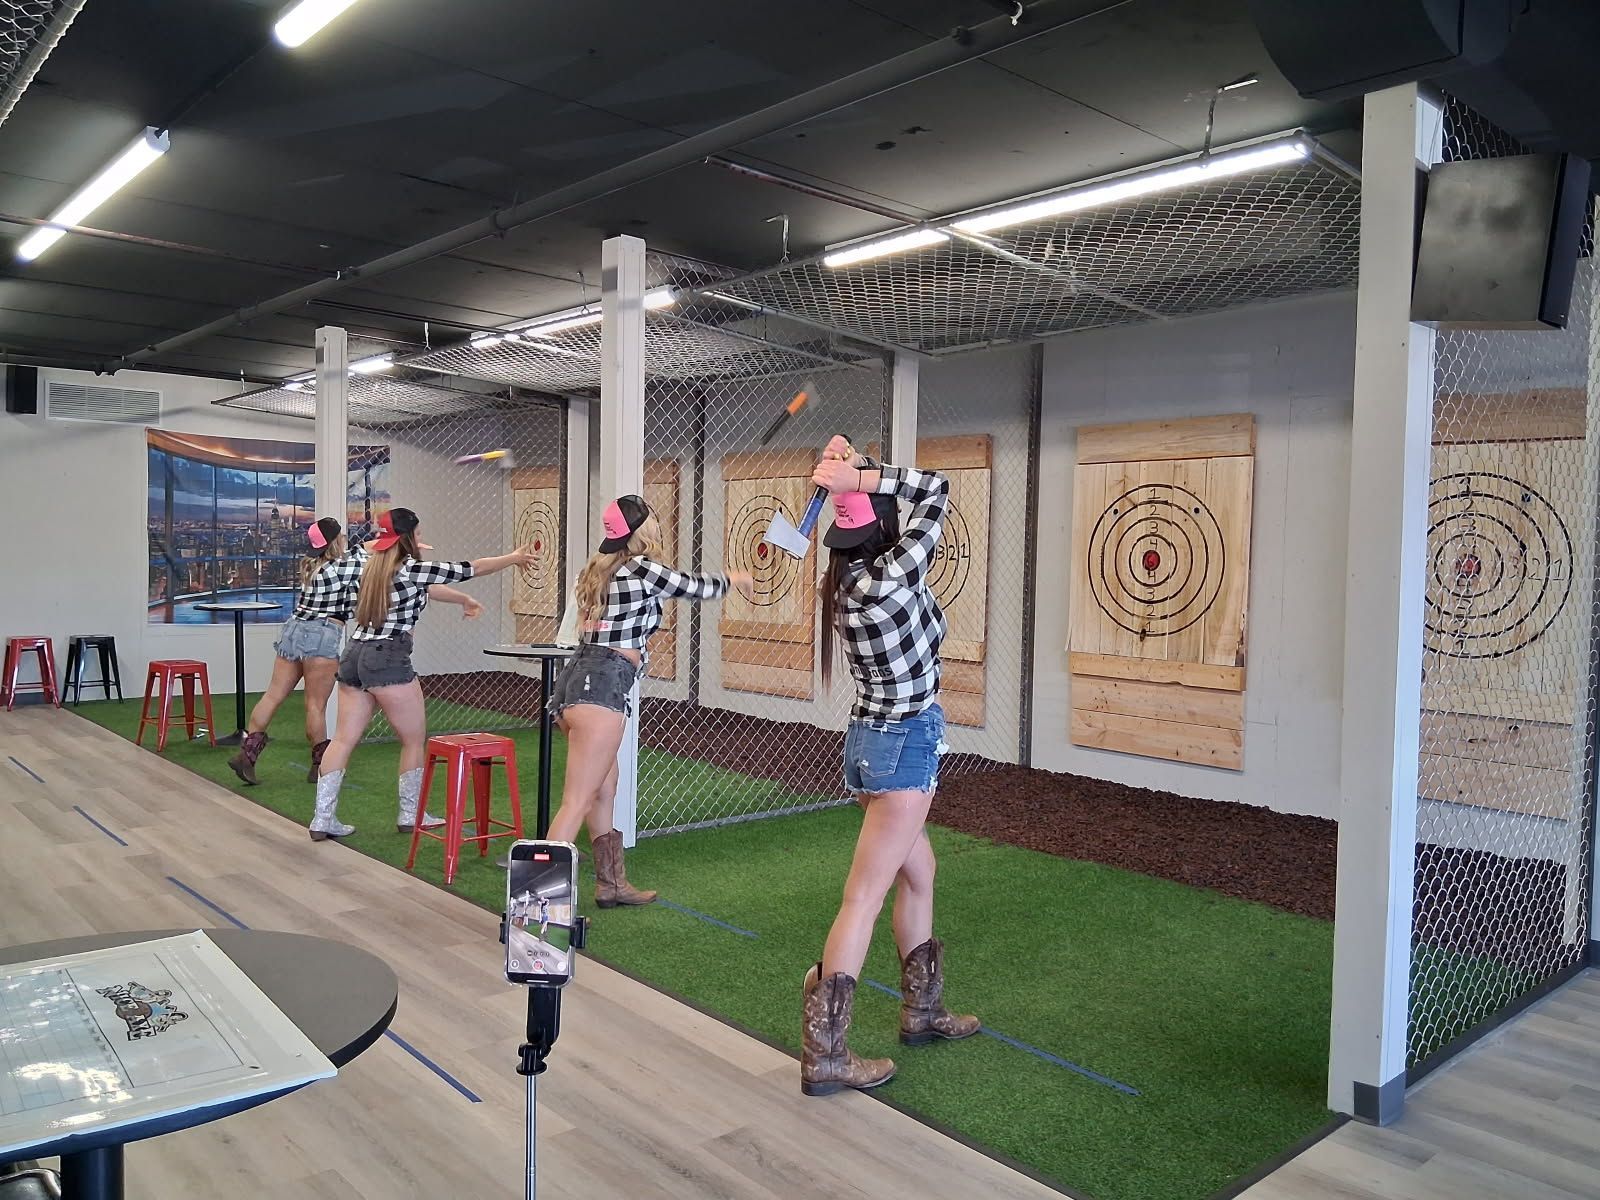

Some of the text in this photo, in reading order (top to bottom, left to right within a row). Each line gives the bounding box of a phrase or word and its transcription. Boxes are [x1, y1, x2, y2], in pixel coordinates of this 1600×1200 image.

[1148, 487, 1161, 500] 1
[1150, 505, 1160, 516] 2
[1150, 521, 1159, 534] 3
[1149, 538, 1158, 550] 4
[938, 542, 969, 561] 3 2 1
[1553, 559, 1565, 581] 1
[1146, 588, 1156, 601] 3
[1146, 604, 1156, 617] 2
[1145, 621, 1156, 633] 1
